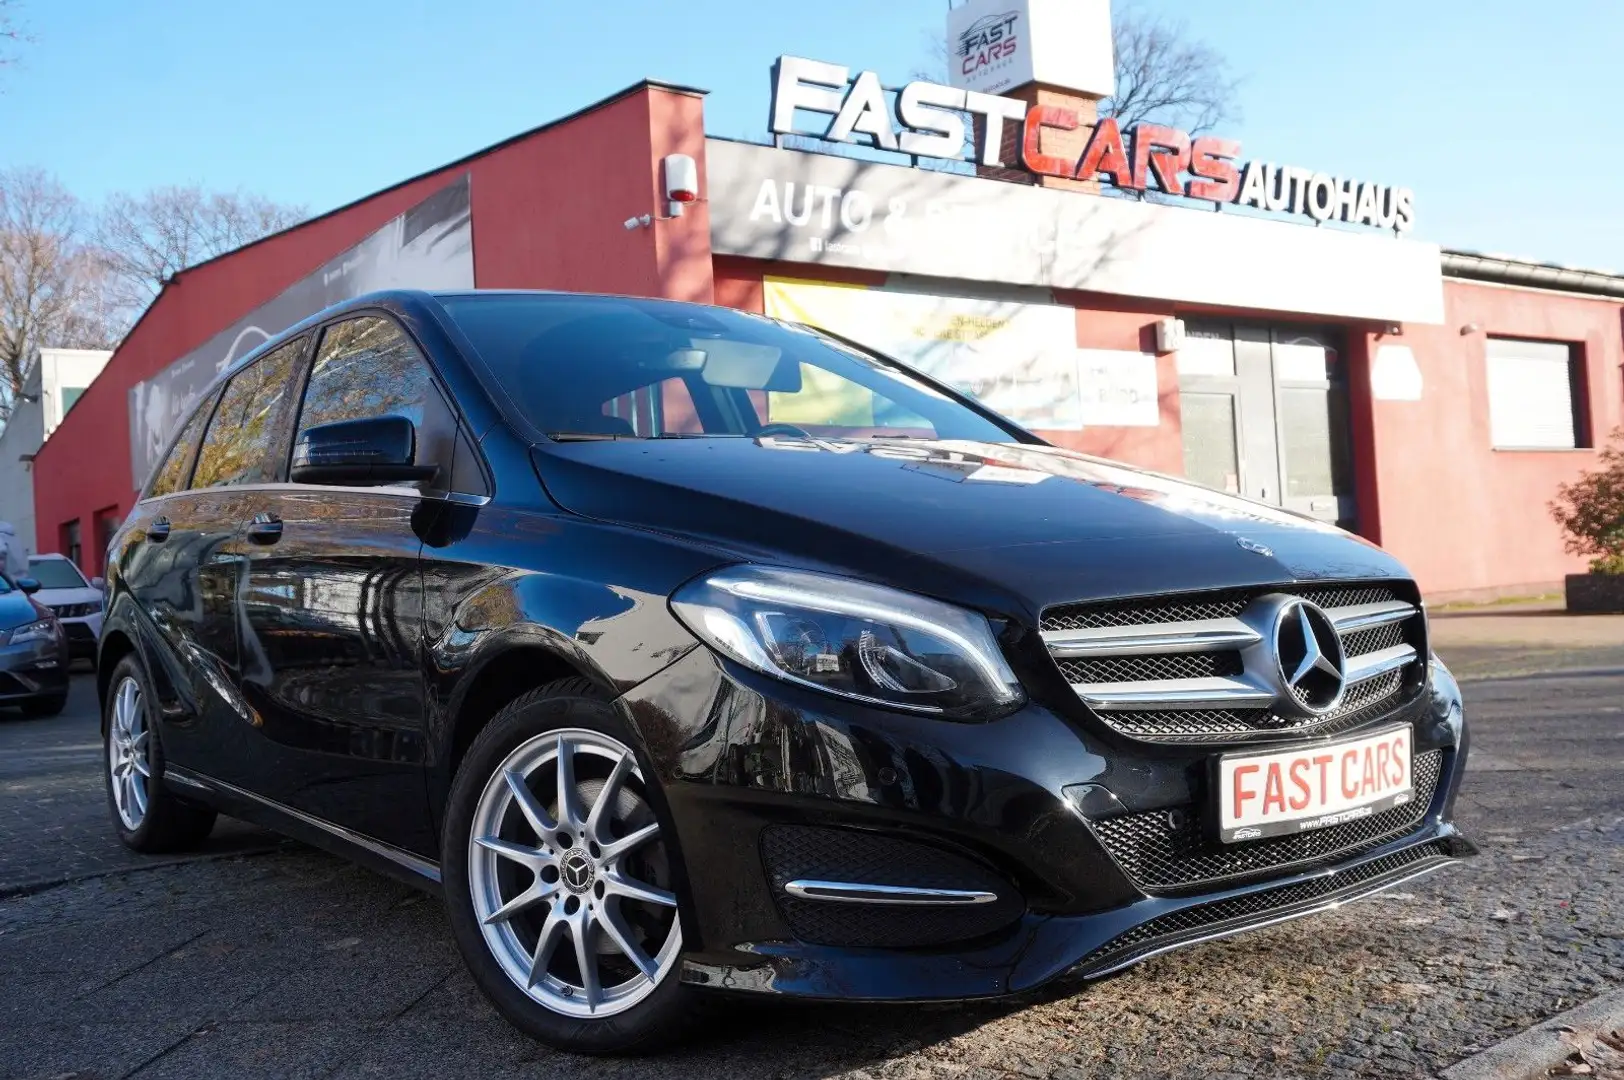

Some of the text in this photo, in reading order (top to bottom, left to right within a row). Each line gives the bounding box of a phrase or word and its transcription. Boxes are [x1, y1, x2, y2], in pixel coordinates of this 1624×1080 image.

[962, 36, 1017, 75] CARS
[965, 14, 1018, 56] FAST
[750, 178, 873, 233] AUTO
[1239, 160, 1416, 232] AUTOHAUS
[1233, 737, 1404, 819] FAST CARS
